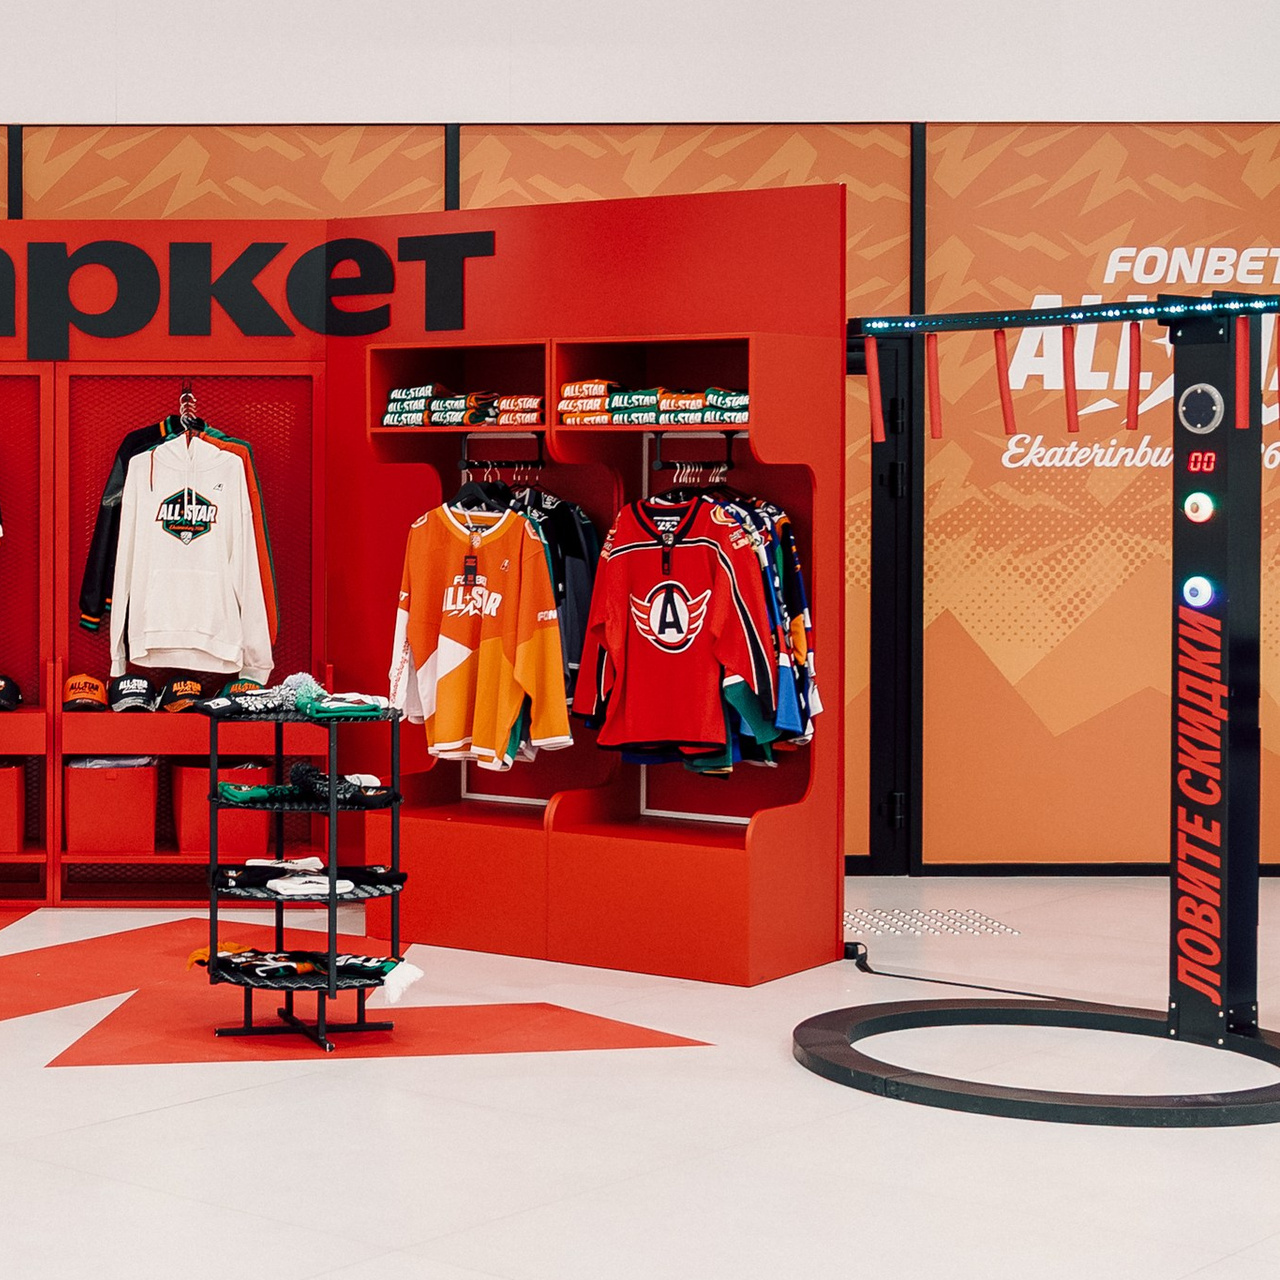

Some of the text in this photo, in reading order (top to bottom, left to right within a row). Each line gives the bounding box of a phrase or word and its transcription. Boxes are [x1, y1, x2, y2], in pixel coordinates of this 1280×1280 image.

[1001, 433, 1174, 469] Ekaterinbu
[1187, 451, 1217, 473] 00
[1177, 605, 1229, 1006] ЛОВИТЕ СКИДКИ
